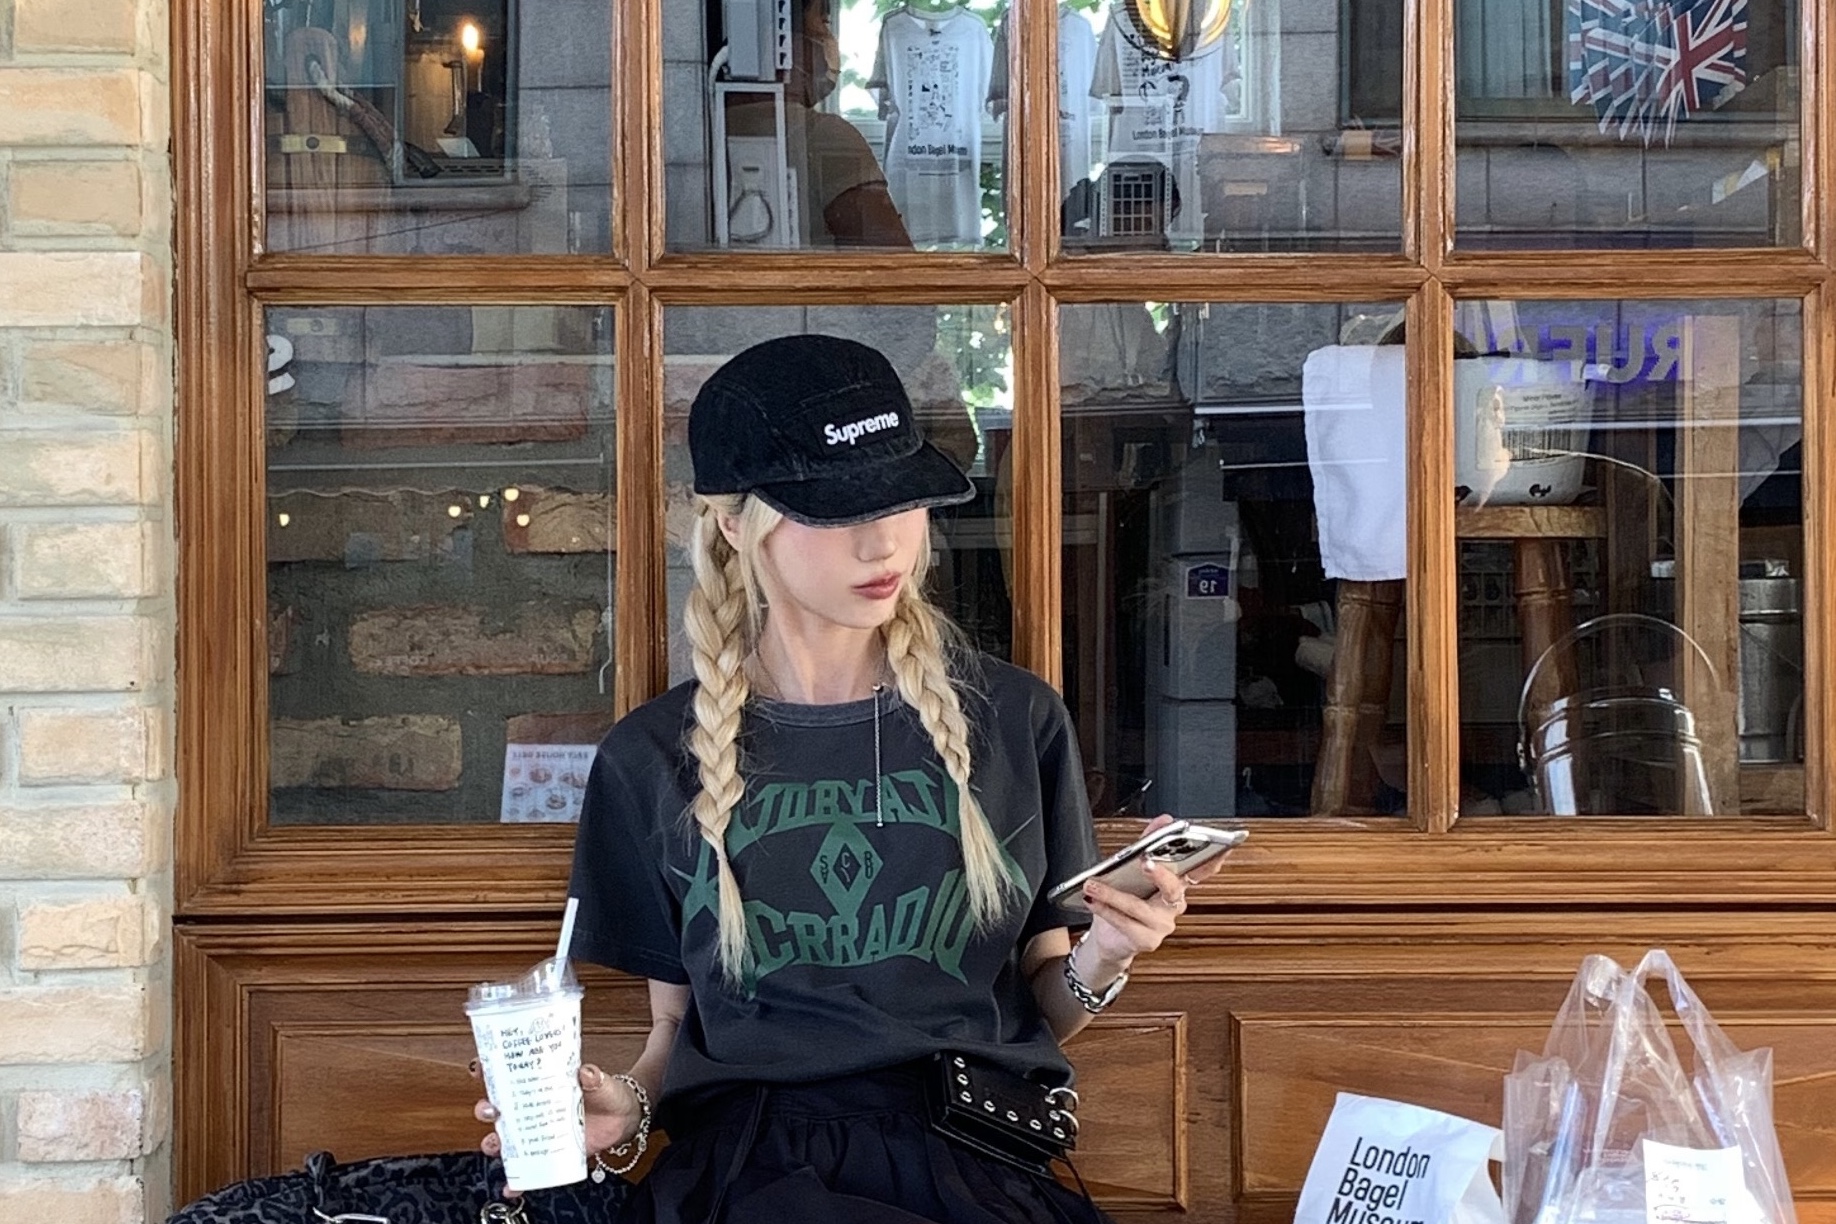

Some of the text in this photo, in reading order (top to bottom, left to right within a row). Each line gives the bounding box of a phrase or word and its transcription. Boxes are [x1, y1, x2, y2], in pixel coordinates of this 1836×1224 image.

[824, 412, 899, 445] Supreme
[1350, 1136, 1431, 1179] London
[1337, 1167, 1409, 1211] Bagel
